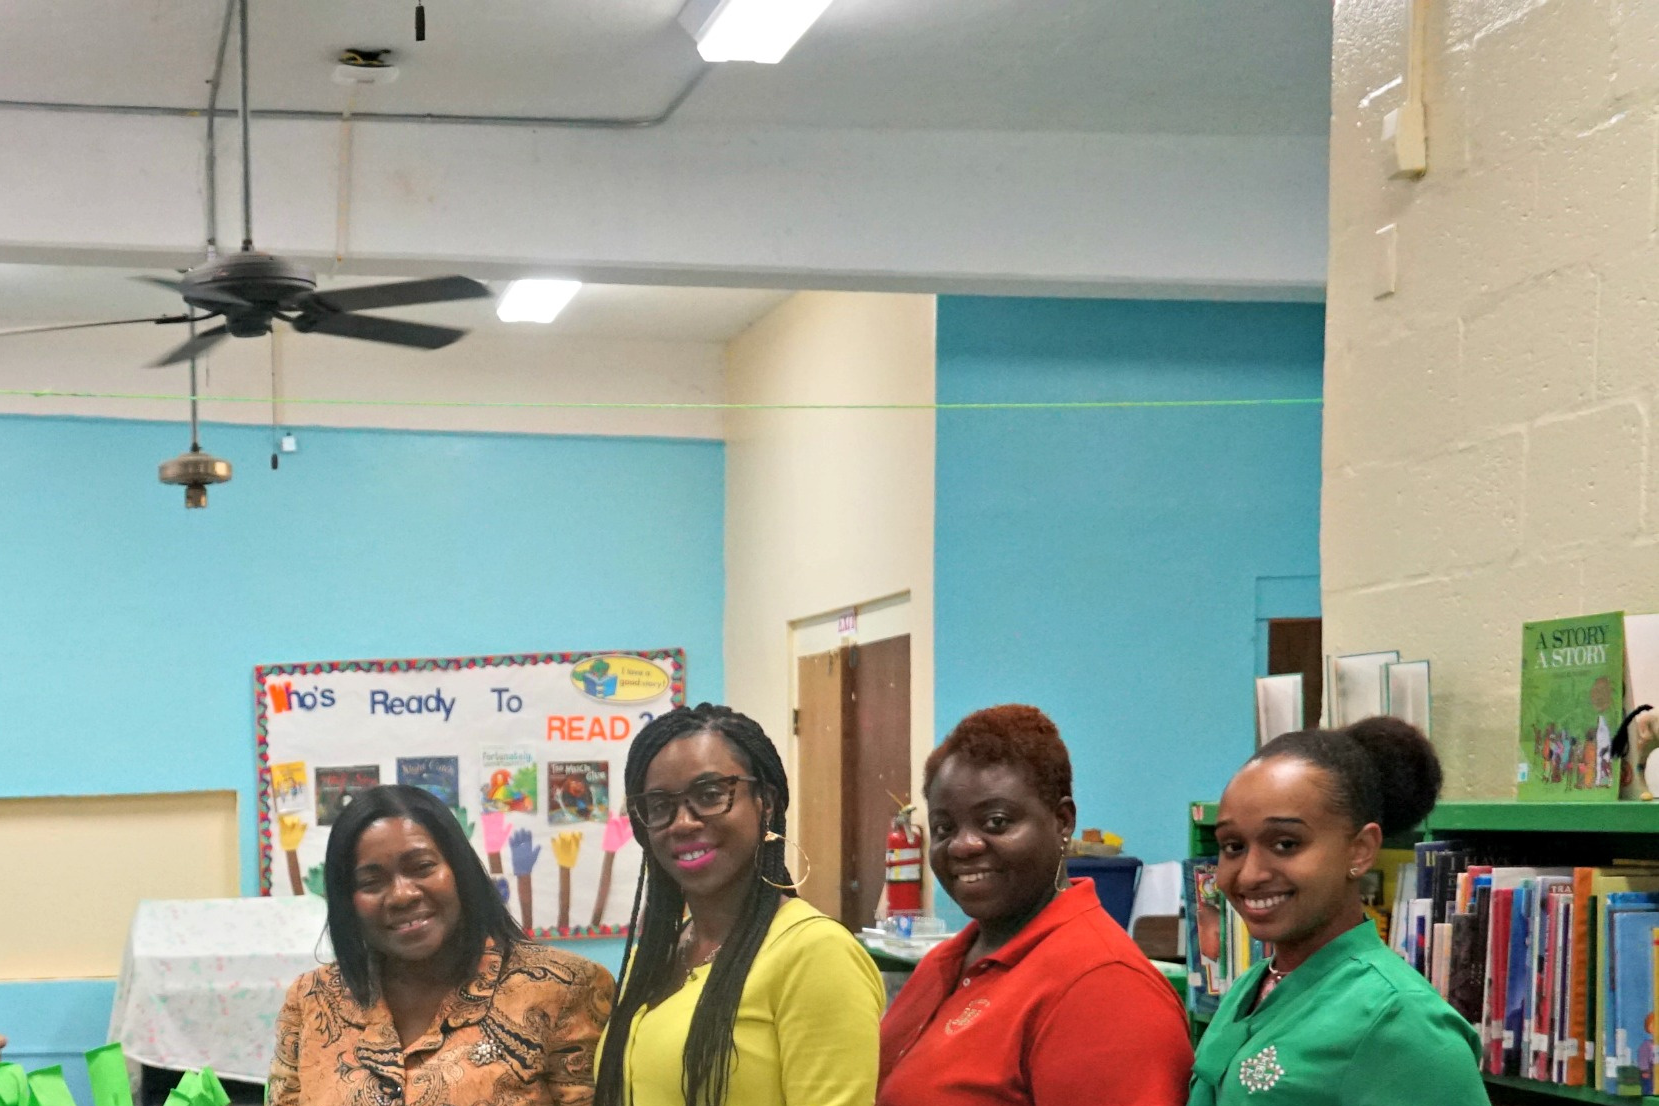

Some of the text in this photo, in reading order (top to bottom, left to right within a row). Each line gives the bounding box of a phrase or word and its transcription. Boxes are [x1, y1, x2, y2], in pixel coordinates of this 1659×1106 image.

[1535, 624, 1609, 650] A STORY
[1535, 643, 1610, 669] A STORY
[619, 678, 640, 687] good
[268, 681, 523, 722] Who's Ready To
[547, 715, 631, 741] READ
